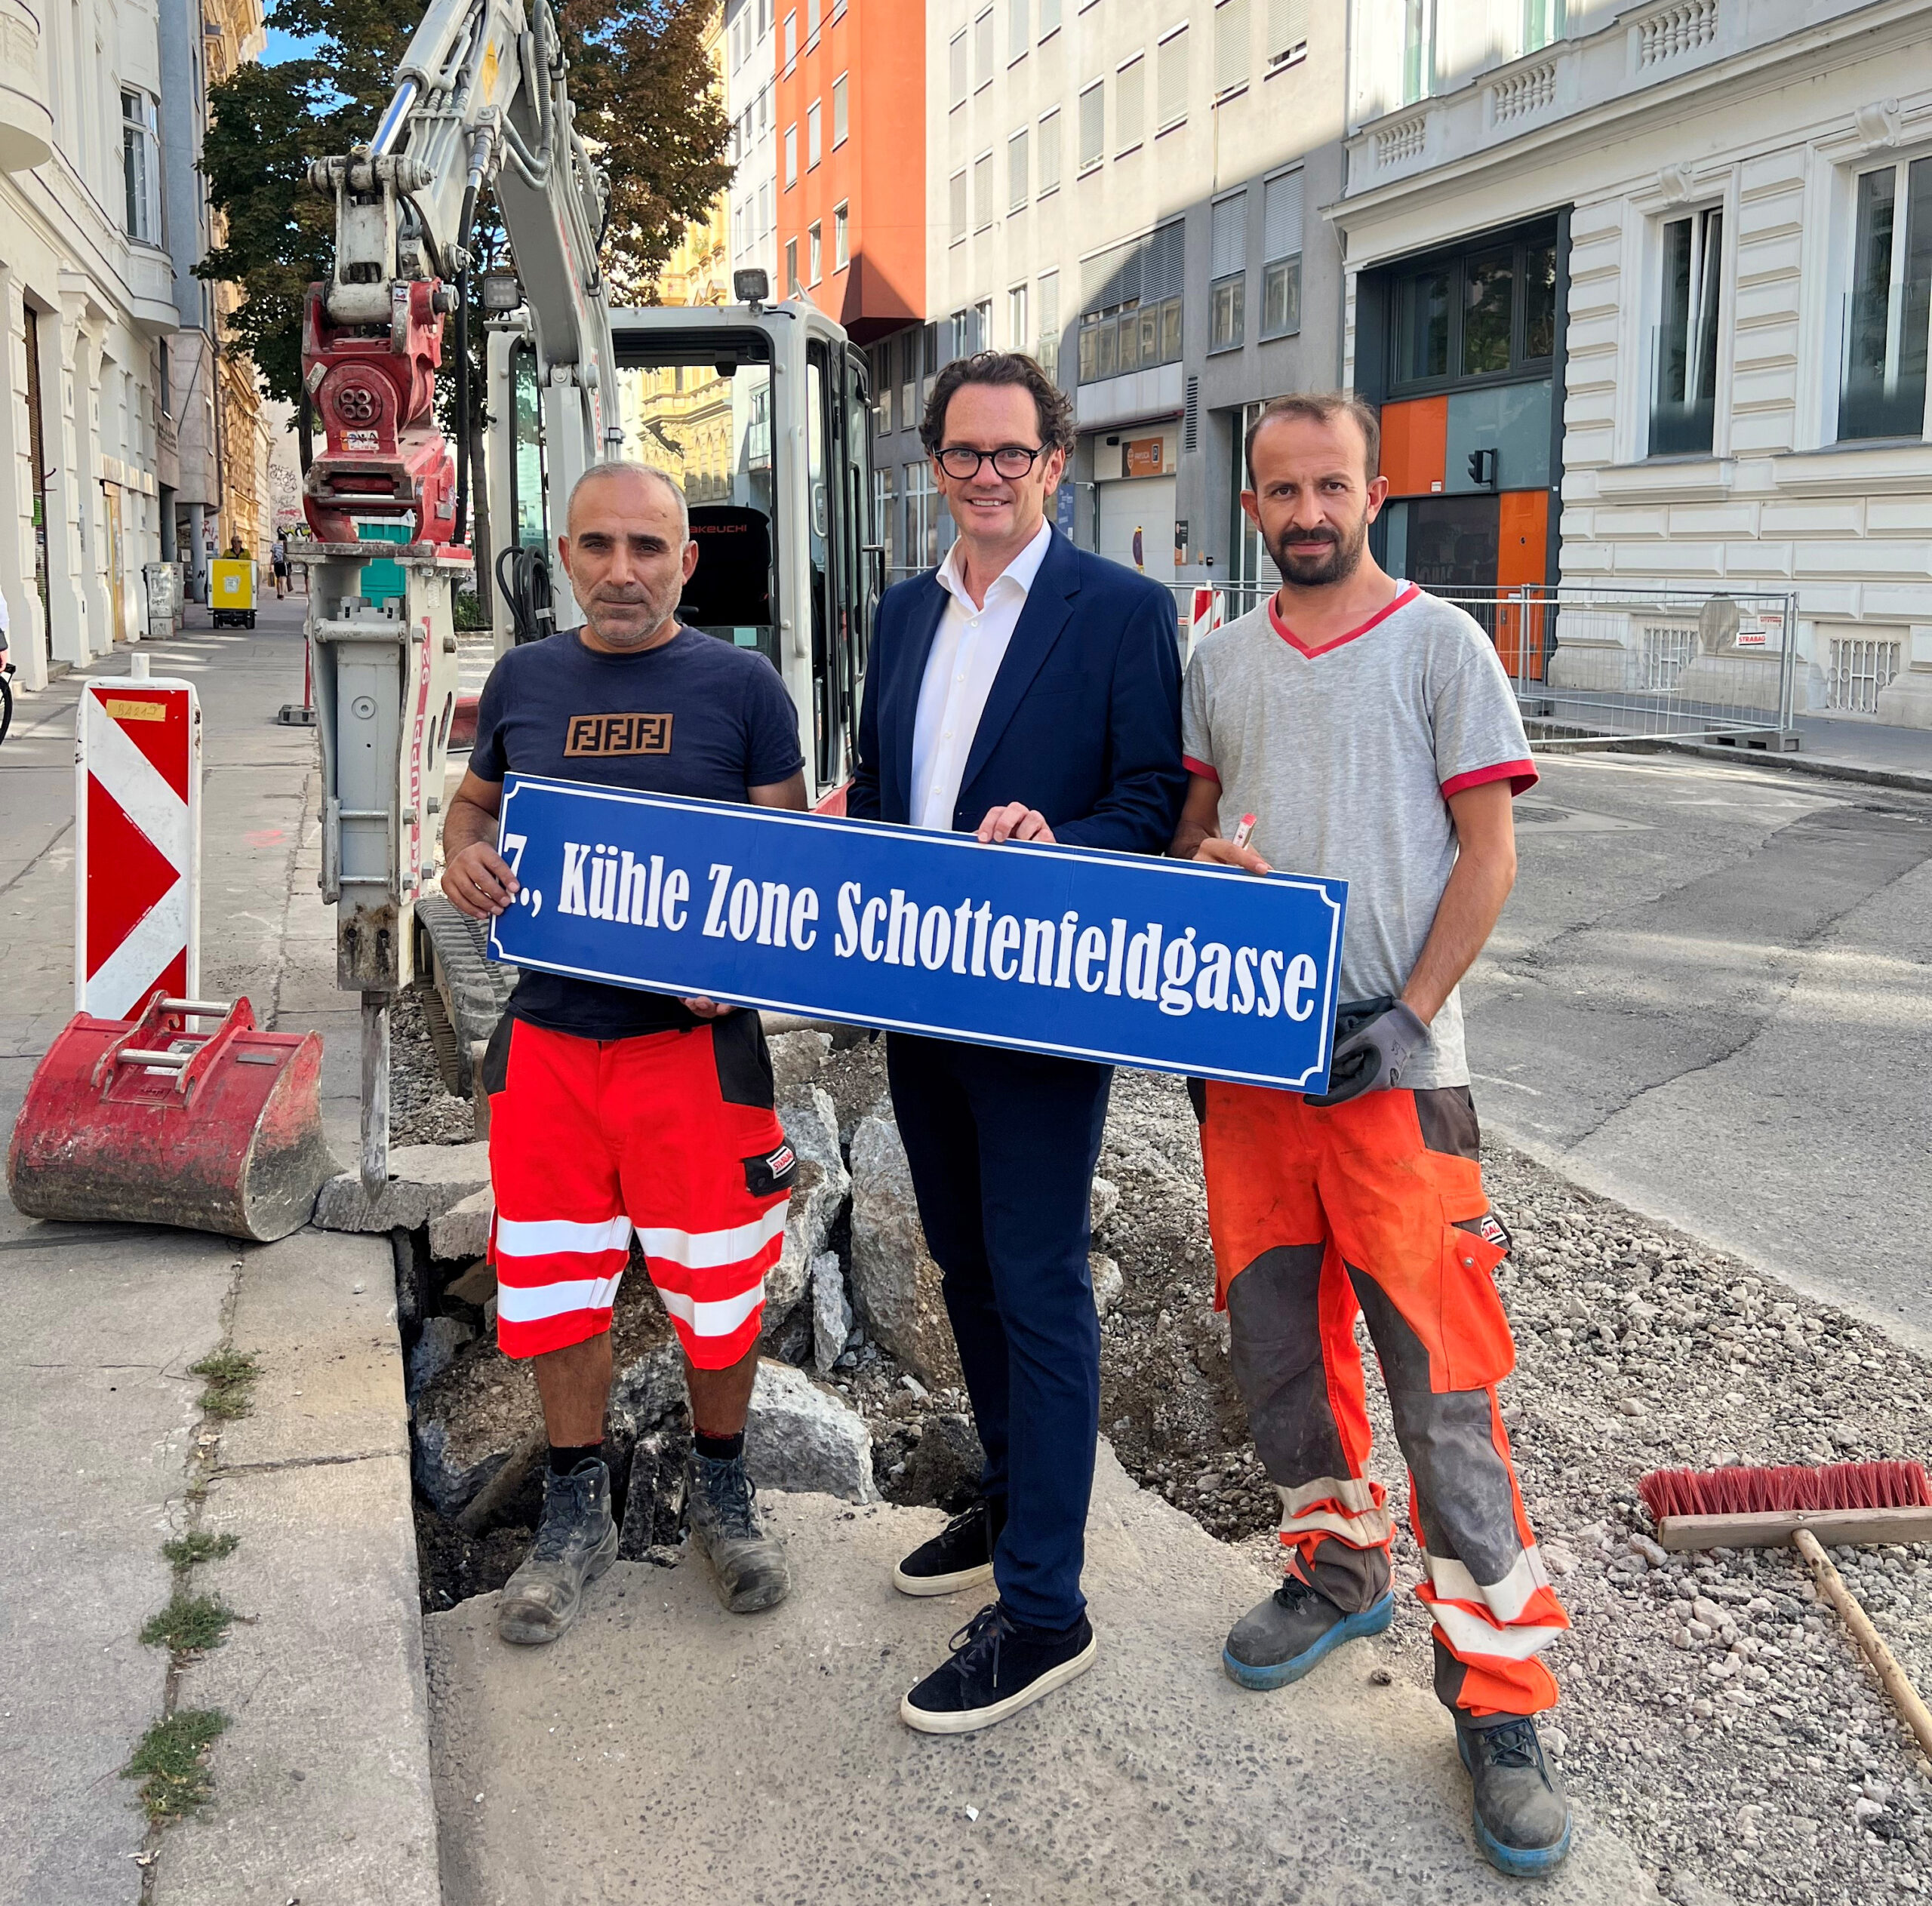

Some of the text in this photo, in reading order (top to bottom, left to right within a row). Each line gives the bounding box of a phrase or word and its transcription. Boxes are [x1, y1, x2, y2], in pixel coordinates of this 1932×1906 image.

[557, 841, 690, 931] Kühle
[702, 863, 819, 951] Zone
[834, 881, 1318, 1022] Schottenfeldgasse
